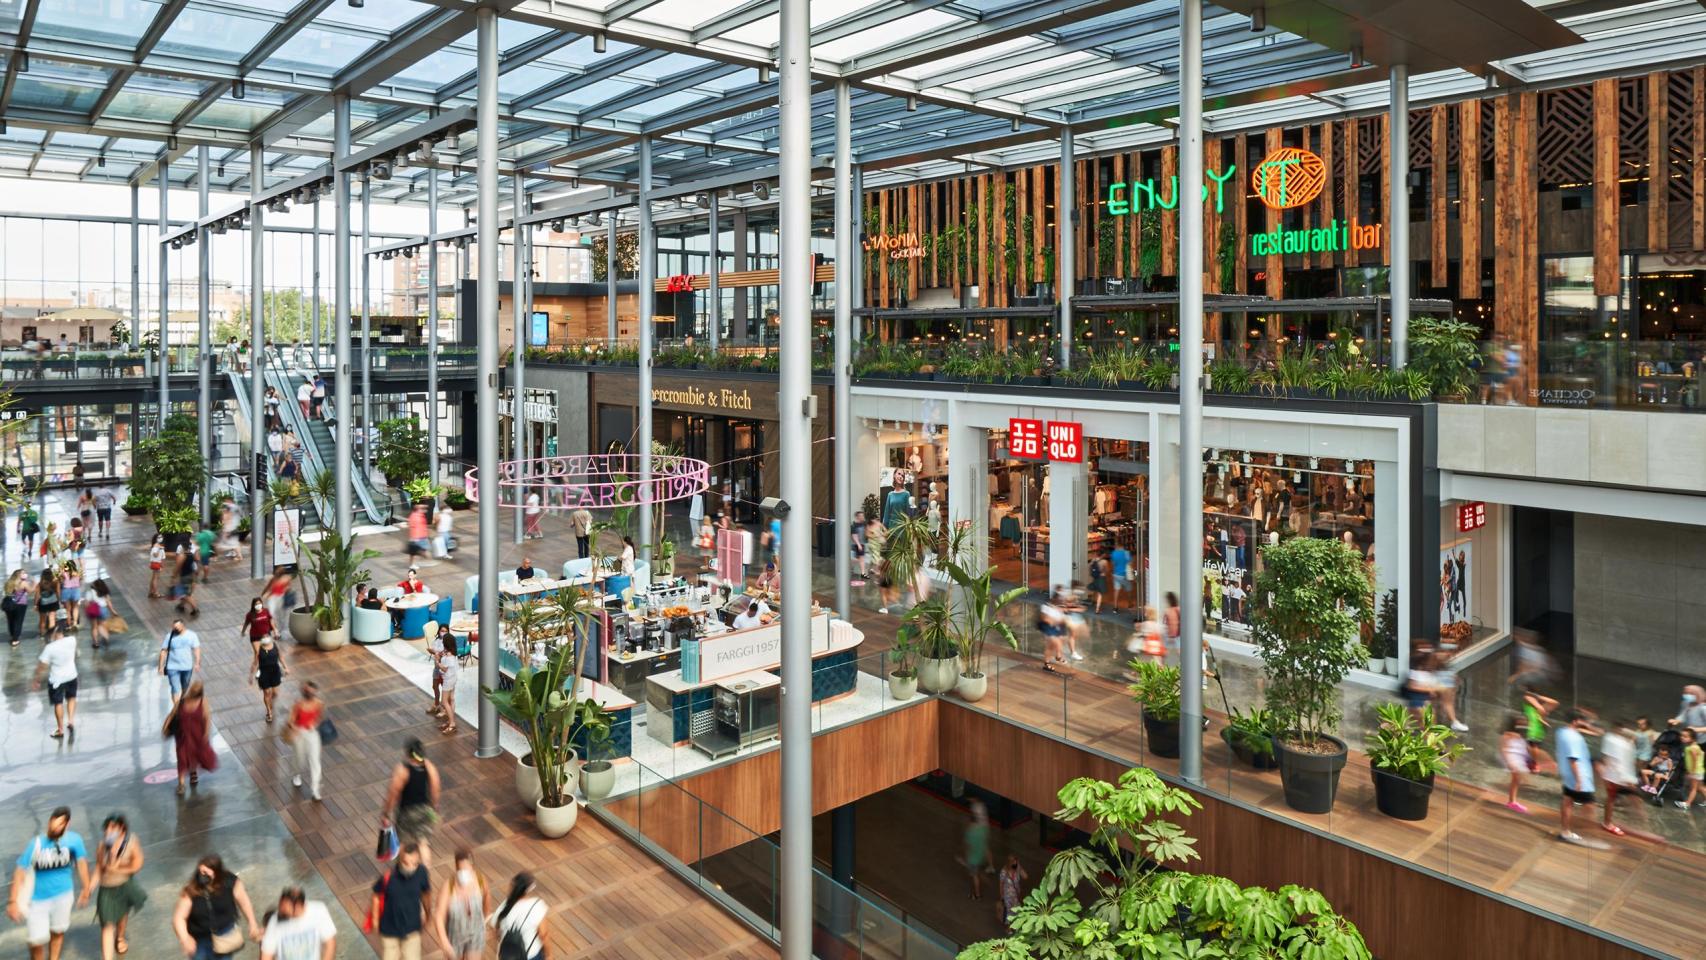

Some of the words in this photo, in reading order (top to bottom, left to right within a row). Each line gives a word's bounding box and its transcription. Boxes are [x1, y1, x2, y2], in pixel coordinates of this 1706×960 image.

[1107, 164, 1236, 215] ENJY
[1252, 219, 1339, 257] restaurant
[1342, 220, 1349, 252] i
[1352, 217, 1382, 250] bar
[651, 385, 705, 407] ercrombie
[708, 391, 718, 407] &
[720, 388, 752, 411] Fitch
[1050, 425, 1074, 442] UNI
[1050, 441, 1077, 459] QLO
[1203, 559, 1248, 578] ifeWear
[716, 645, 754, 663] FARGGI
[756, 639, 779, 655] 1957
